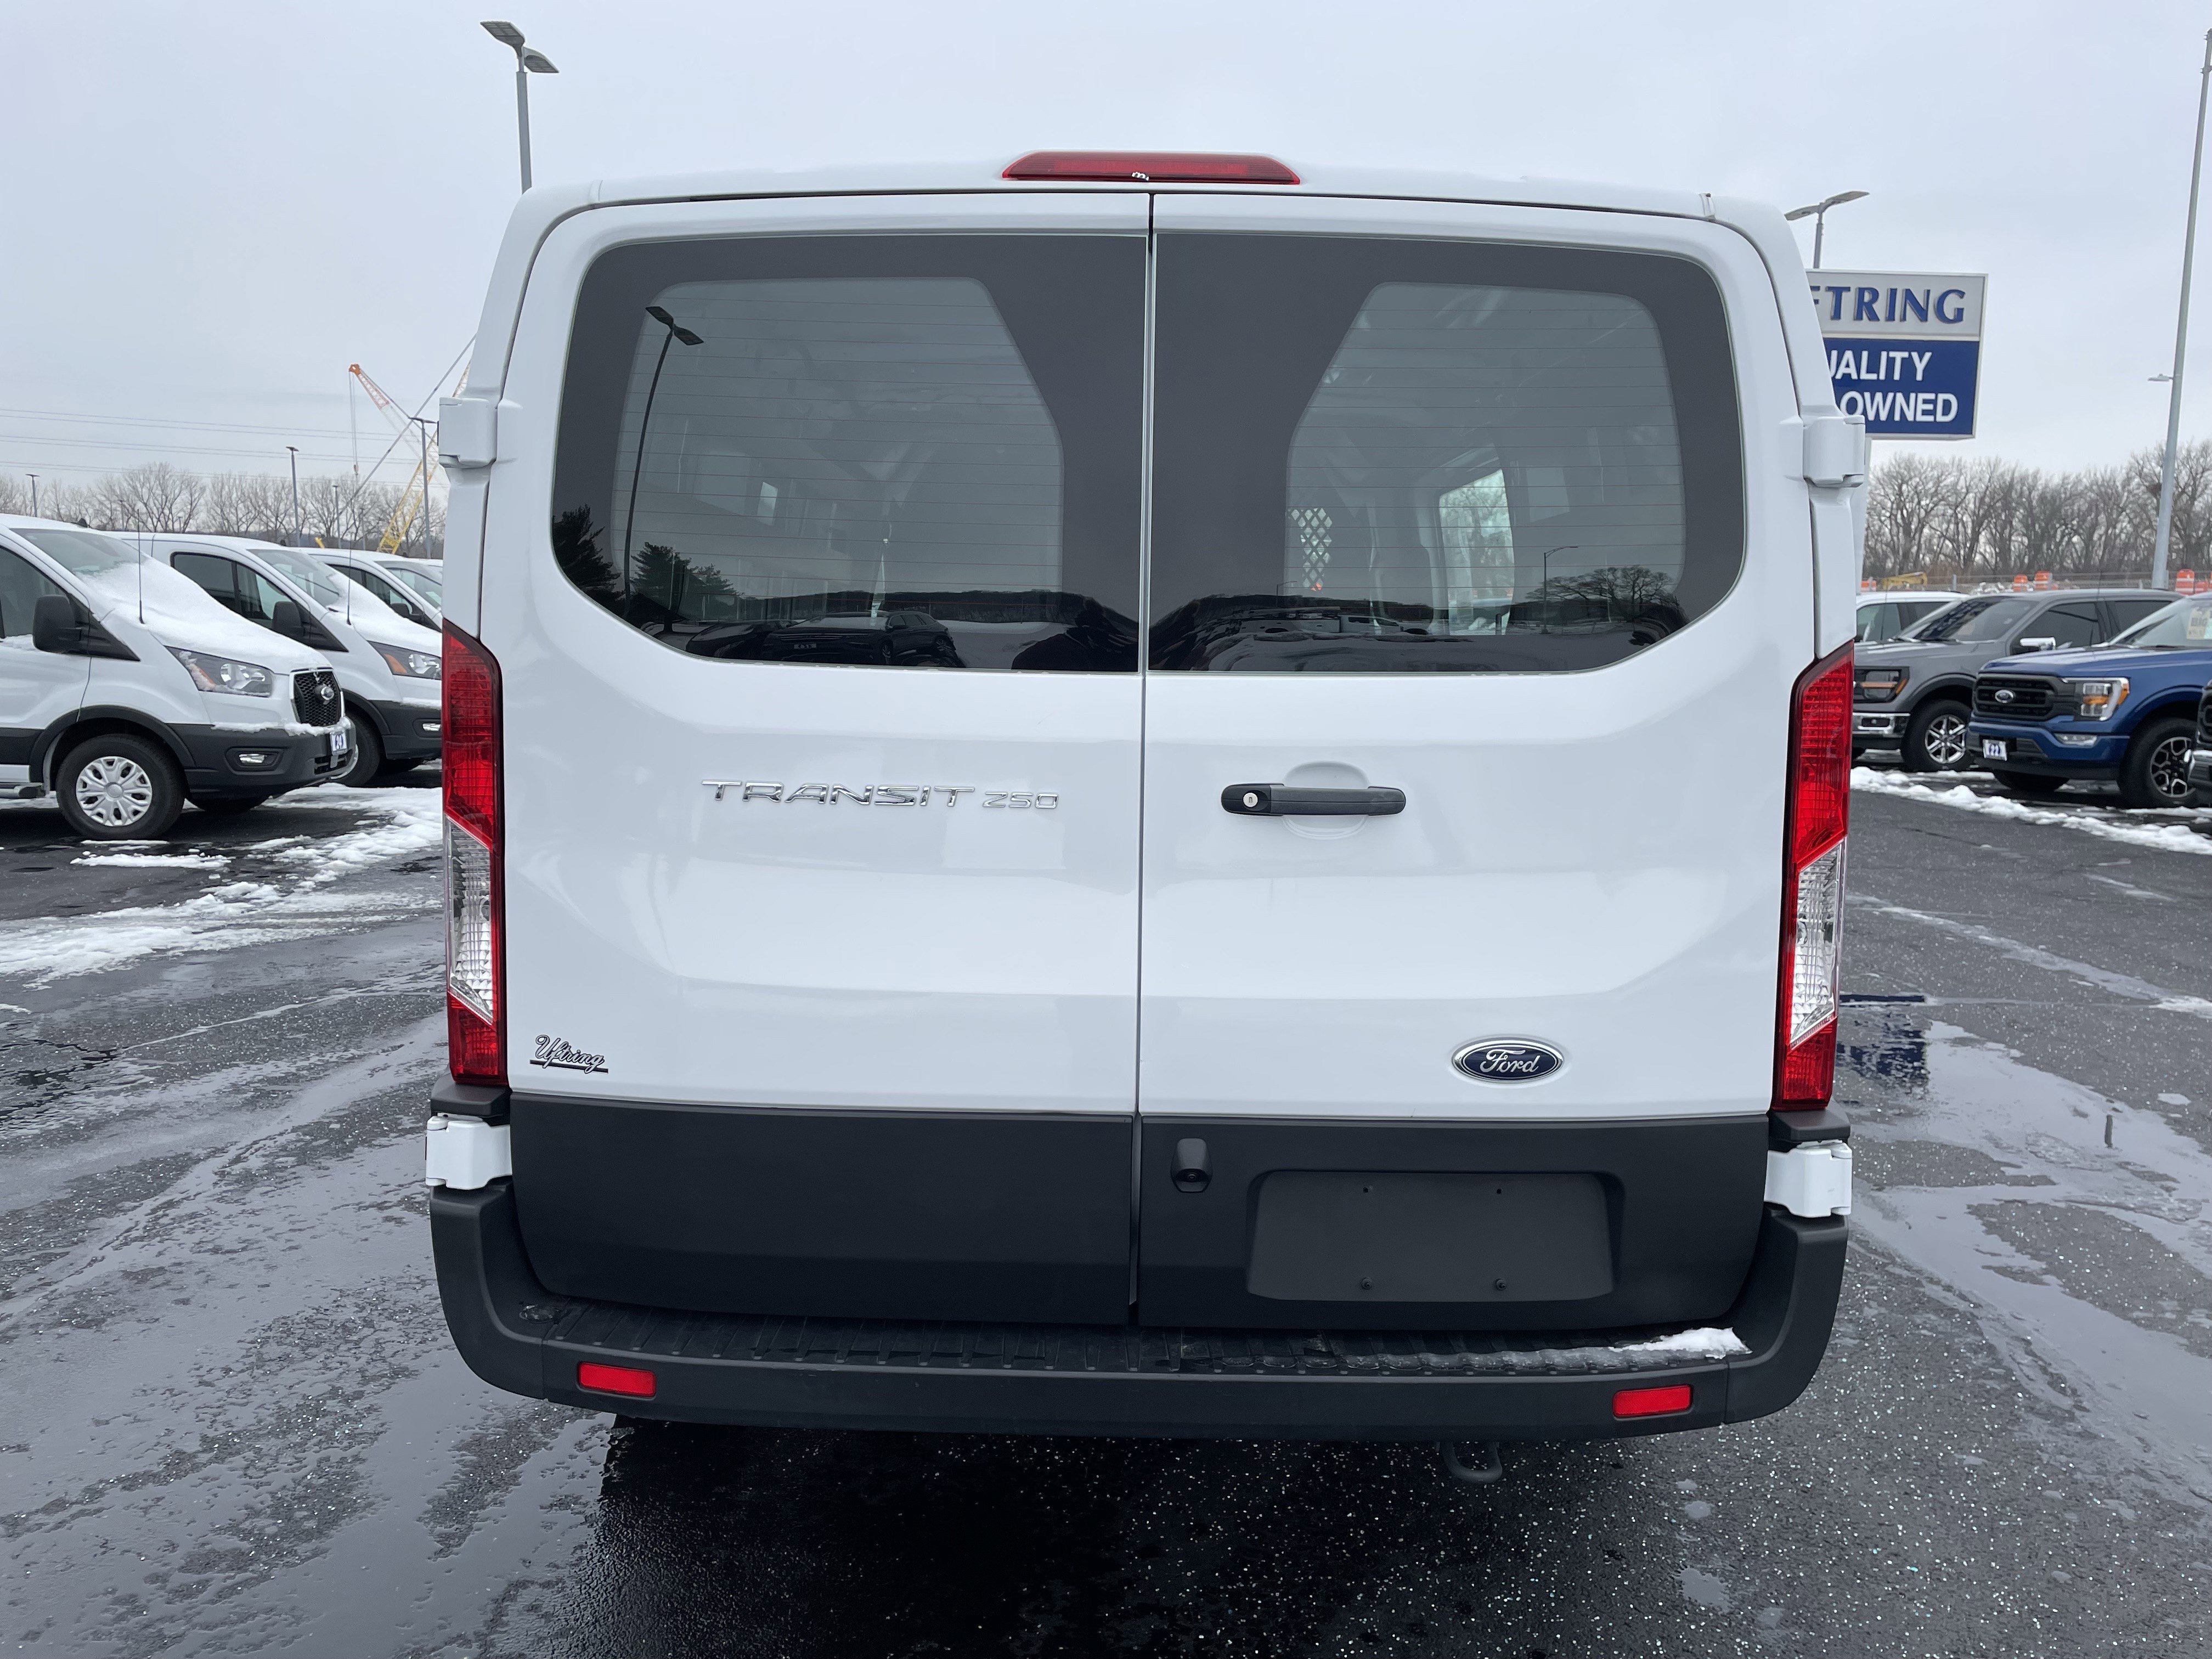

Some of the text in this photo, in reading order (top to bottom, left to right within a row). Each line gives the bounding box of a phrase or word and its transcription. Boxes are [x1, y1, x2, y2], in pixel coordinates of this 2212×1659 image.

[1839, 390, 1959, 423] OWNED
[701, 780, 1060, 808] TRANSIT 250
[535, 1034, 605, 1074] Uftring
[1480, 1049, 1541, 1073] Ford
